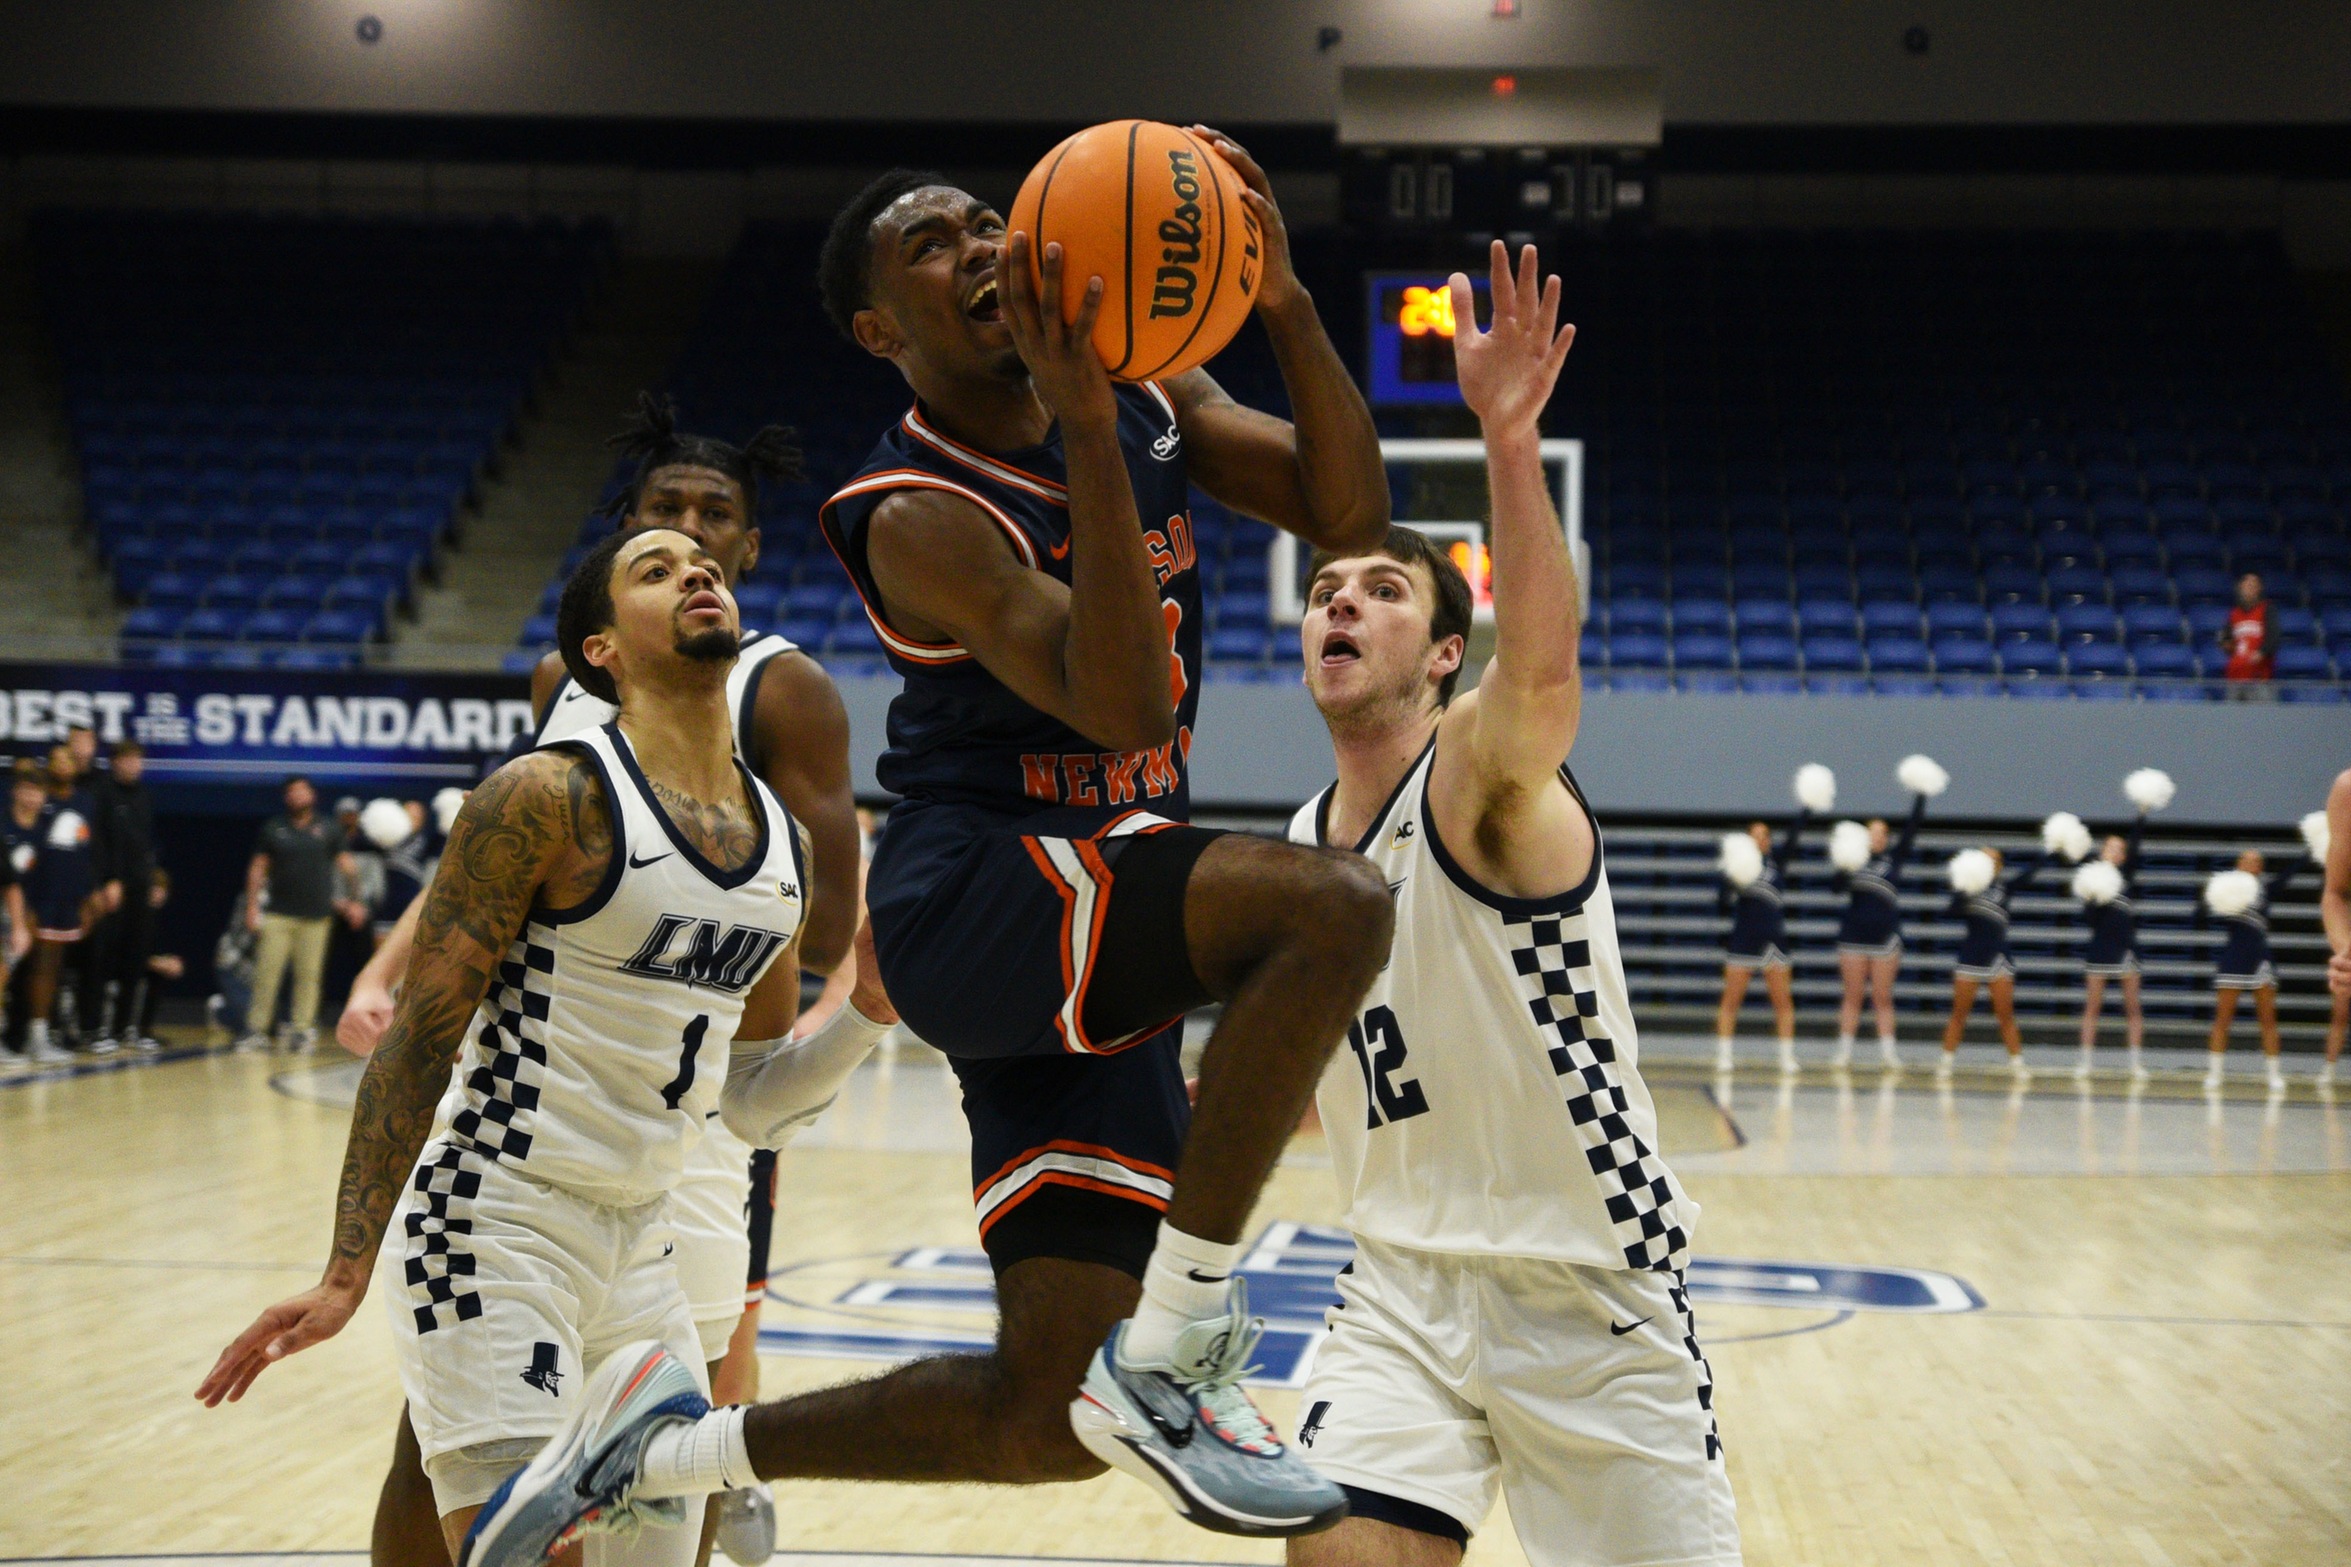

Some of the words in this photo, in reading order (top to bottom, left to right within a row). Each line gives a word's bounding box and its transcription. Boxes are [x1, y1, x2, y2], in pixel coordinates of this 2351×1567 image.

[1149, 149, 1202, 320] Wilson
[1153, 424, 1180, 456] SAC
[134, 716, 191, 745] THE
[195, 695, 535, 751] STANDARD
[1394, 820, 1414, 842] AC
[617, 913, 791, 993] LMU
[661, 1014, 709, 1110] 1
[1347, 1004, 1430, 1130] 12
